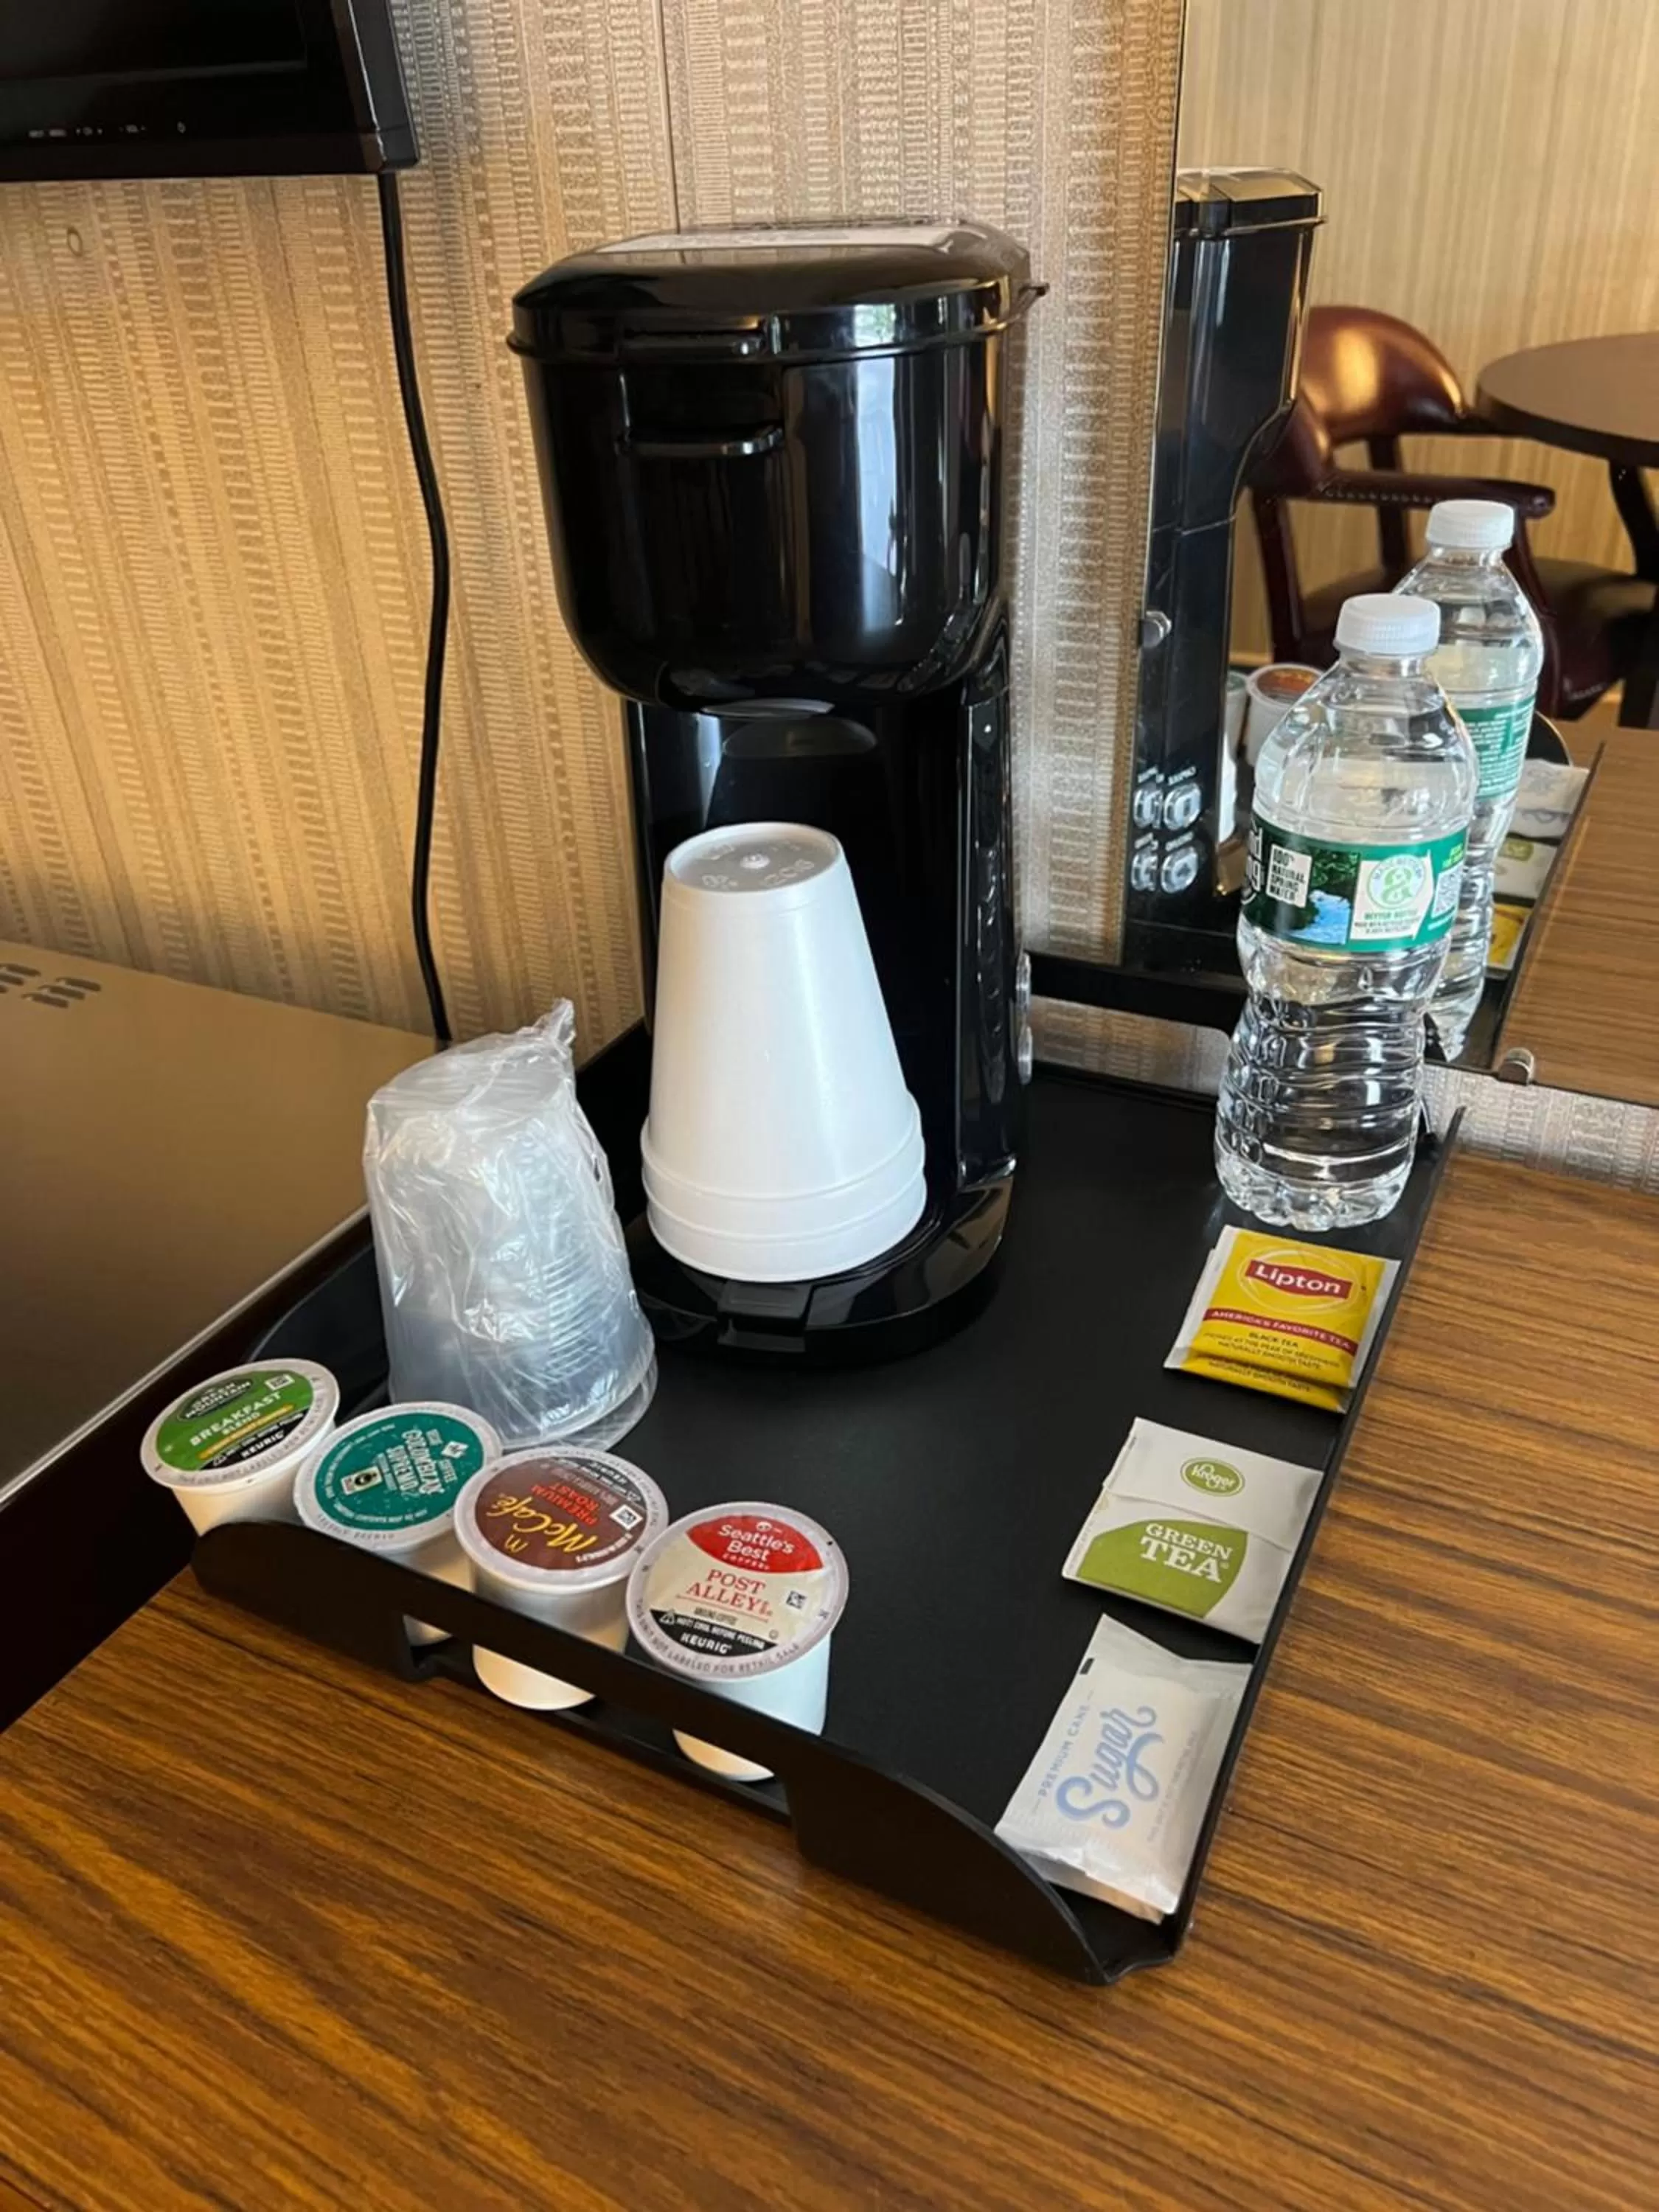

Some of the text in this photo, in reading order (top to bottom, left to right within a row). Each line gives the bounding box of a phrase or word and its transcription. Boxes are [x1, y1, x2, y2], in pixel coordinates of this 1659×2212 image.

[1270, 885, 1295, 900] WATER
[1255, 1264, 1342, 1295] Lipton
[1248, 1332, 1299, 1348] BLACK TEA
[1272, 1321, 1328, 1341] FAVORITE
[1329, 1335, 1352, 1350] TEA
[185, 1381, 251, 1419] MOUNTAIN
[189, 1391, 281, 1446] BREAKFAST
[222, 1411, 260, 1436] BLEND
[240, 1430, 285, 1458] KEURIG
[1191, 1461, 1237, 1492] Kroger
[530, 1483, 599, 1526] PREMIUM
[550, 1481, 601, 1512] ROAST
[718, 1523, 796, 1555] Seattle's
[726, 1540, 771, 1562] Best
[1145, 1523, 1234, 1561] GREEN
[1141, 1536, 1223, 1584] TEA
[707, 1568, 767, 1595] POST
[680, 1632, 728, 1655] KEURIG
[1038, 1704, 1091, 1798] PREMIUM CANE
[1055, 1705, 1165, 1829] Sugar
